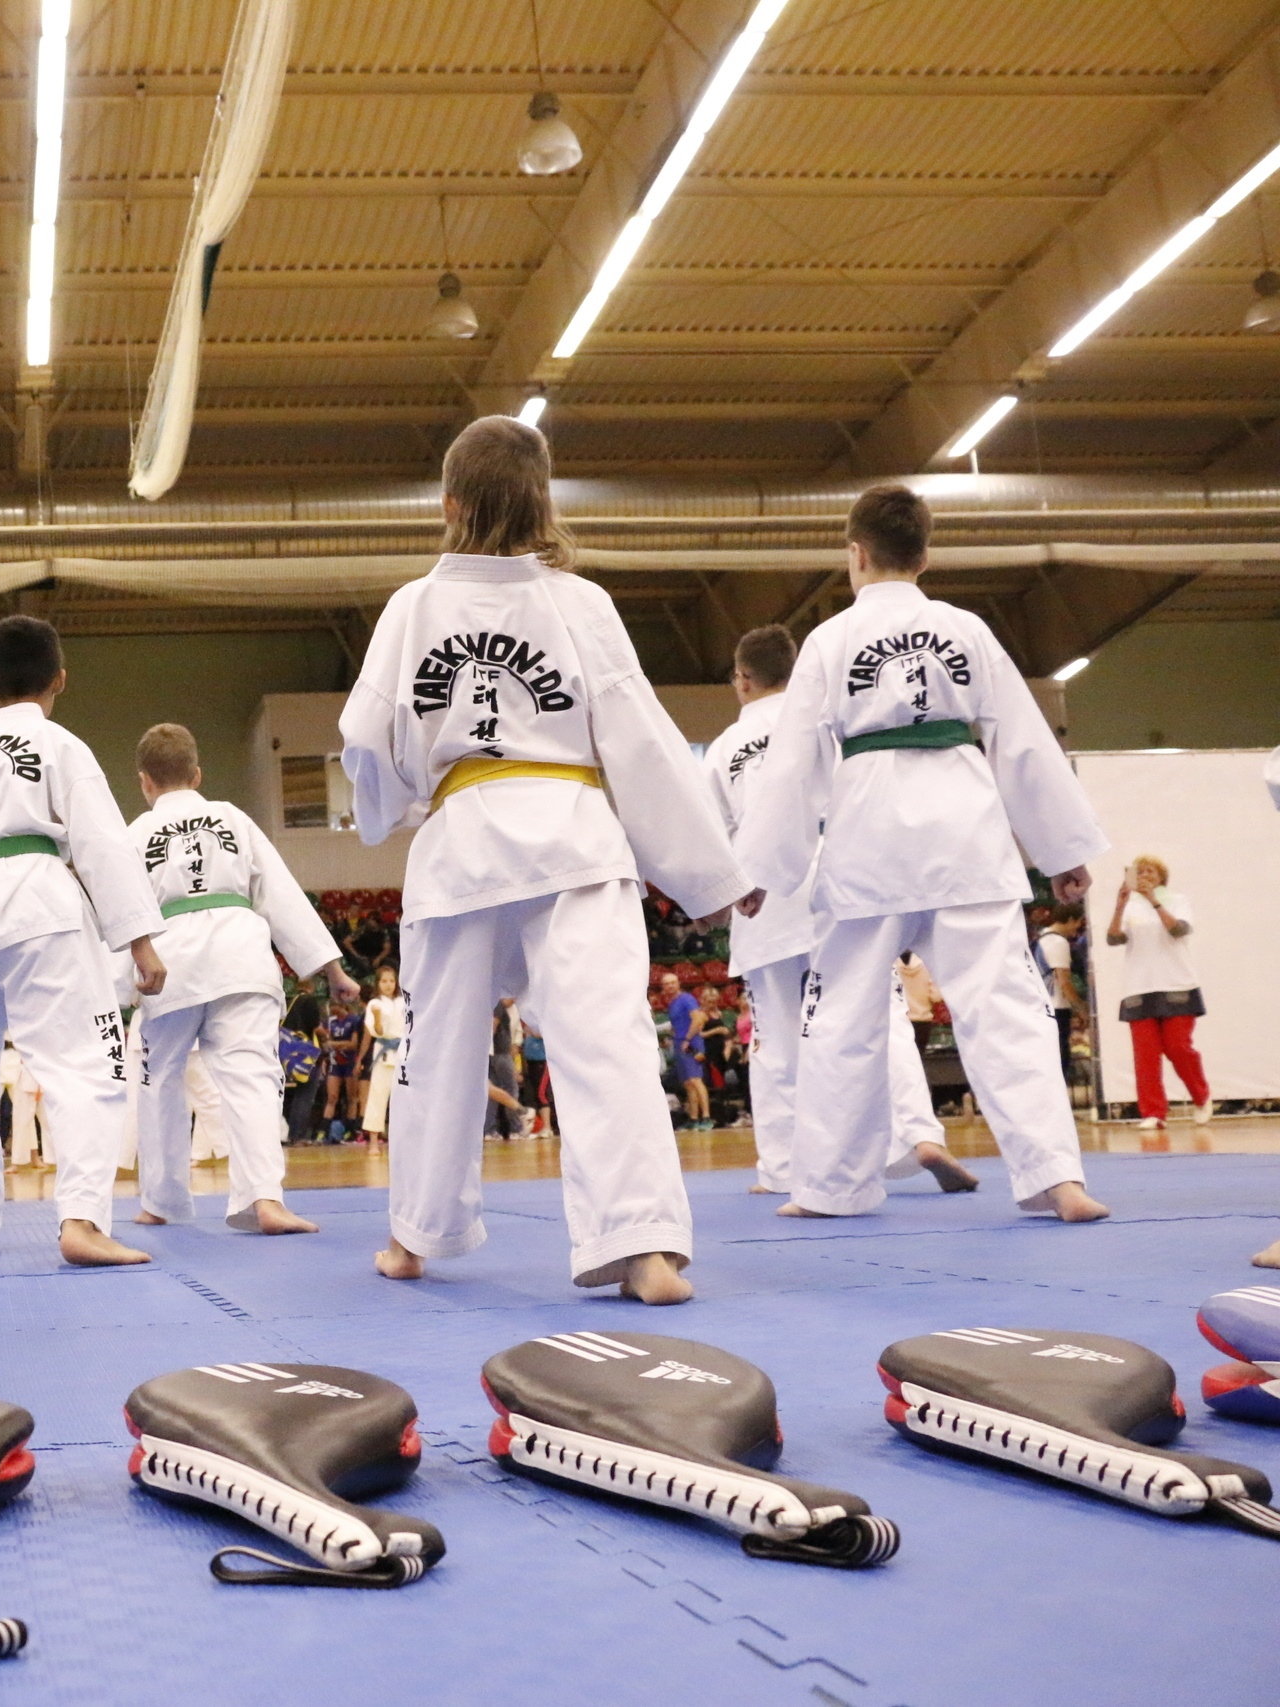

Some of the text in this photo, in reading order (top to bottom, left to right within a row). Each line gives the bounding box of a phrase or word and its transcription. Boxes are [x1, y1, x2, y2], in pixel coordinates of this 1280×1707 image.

[848, 631, 971, 697] TAEKWON-DO
[901, 653, 925, 668] ITF
[413, 632, 574, 720] TAEKWON-DO
[473, 665, 500, 683] ITF
[145, 816, 238, 873] TAEKWON-DO
[182, 832, 199, 845] ITF
[94, 1011, 116, 1026] ITF
